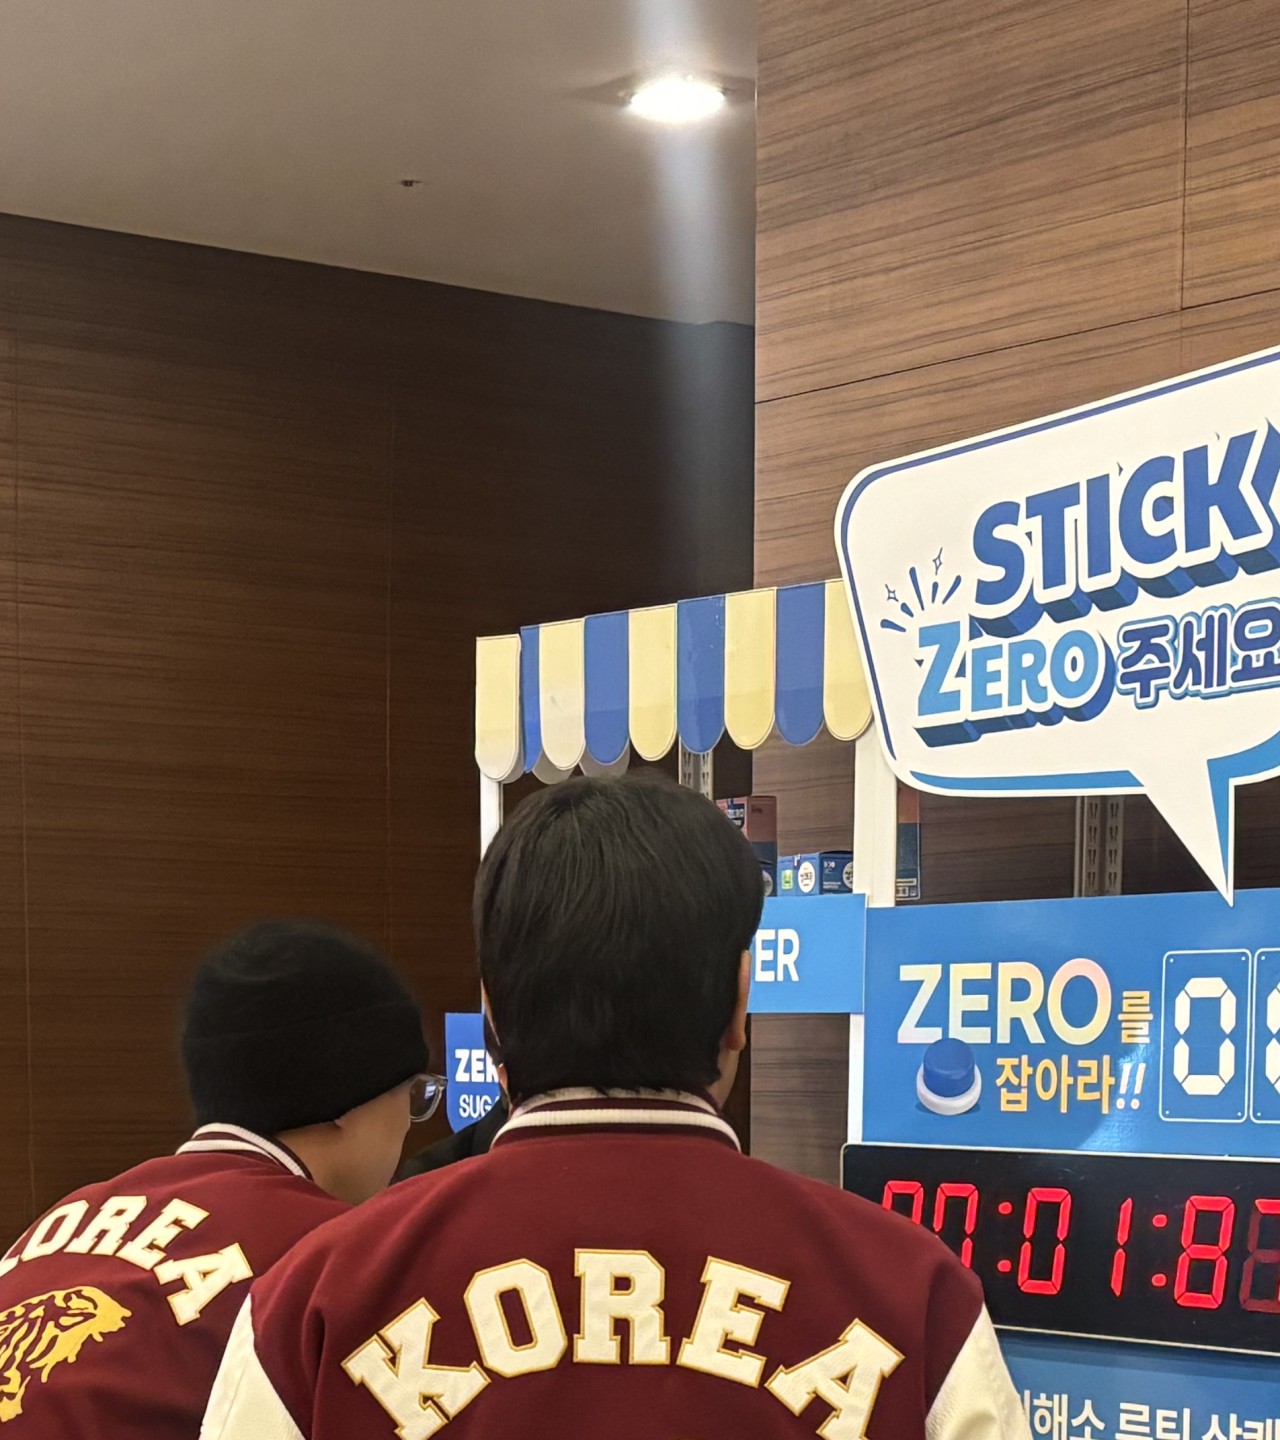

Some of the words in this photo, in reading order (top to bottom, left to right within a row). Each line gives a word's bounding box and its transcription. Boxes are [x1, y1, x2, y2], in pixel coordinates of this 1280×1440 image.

[914, 605, 1116, 748] ZERO
[455, 1049, 499, 1083] ZER
[995, 1053, 1147, 1114] 잡아라!!
[459, 1094, 500, 1119] SUG
